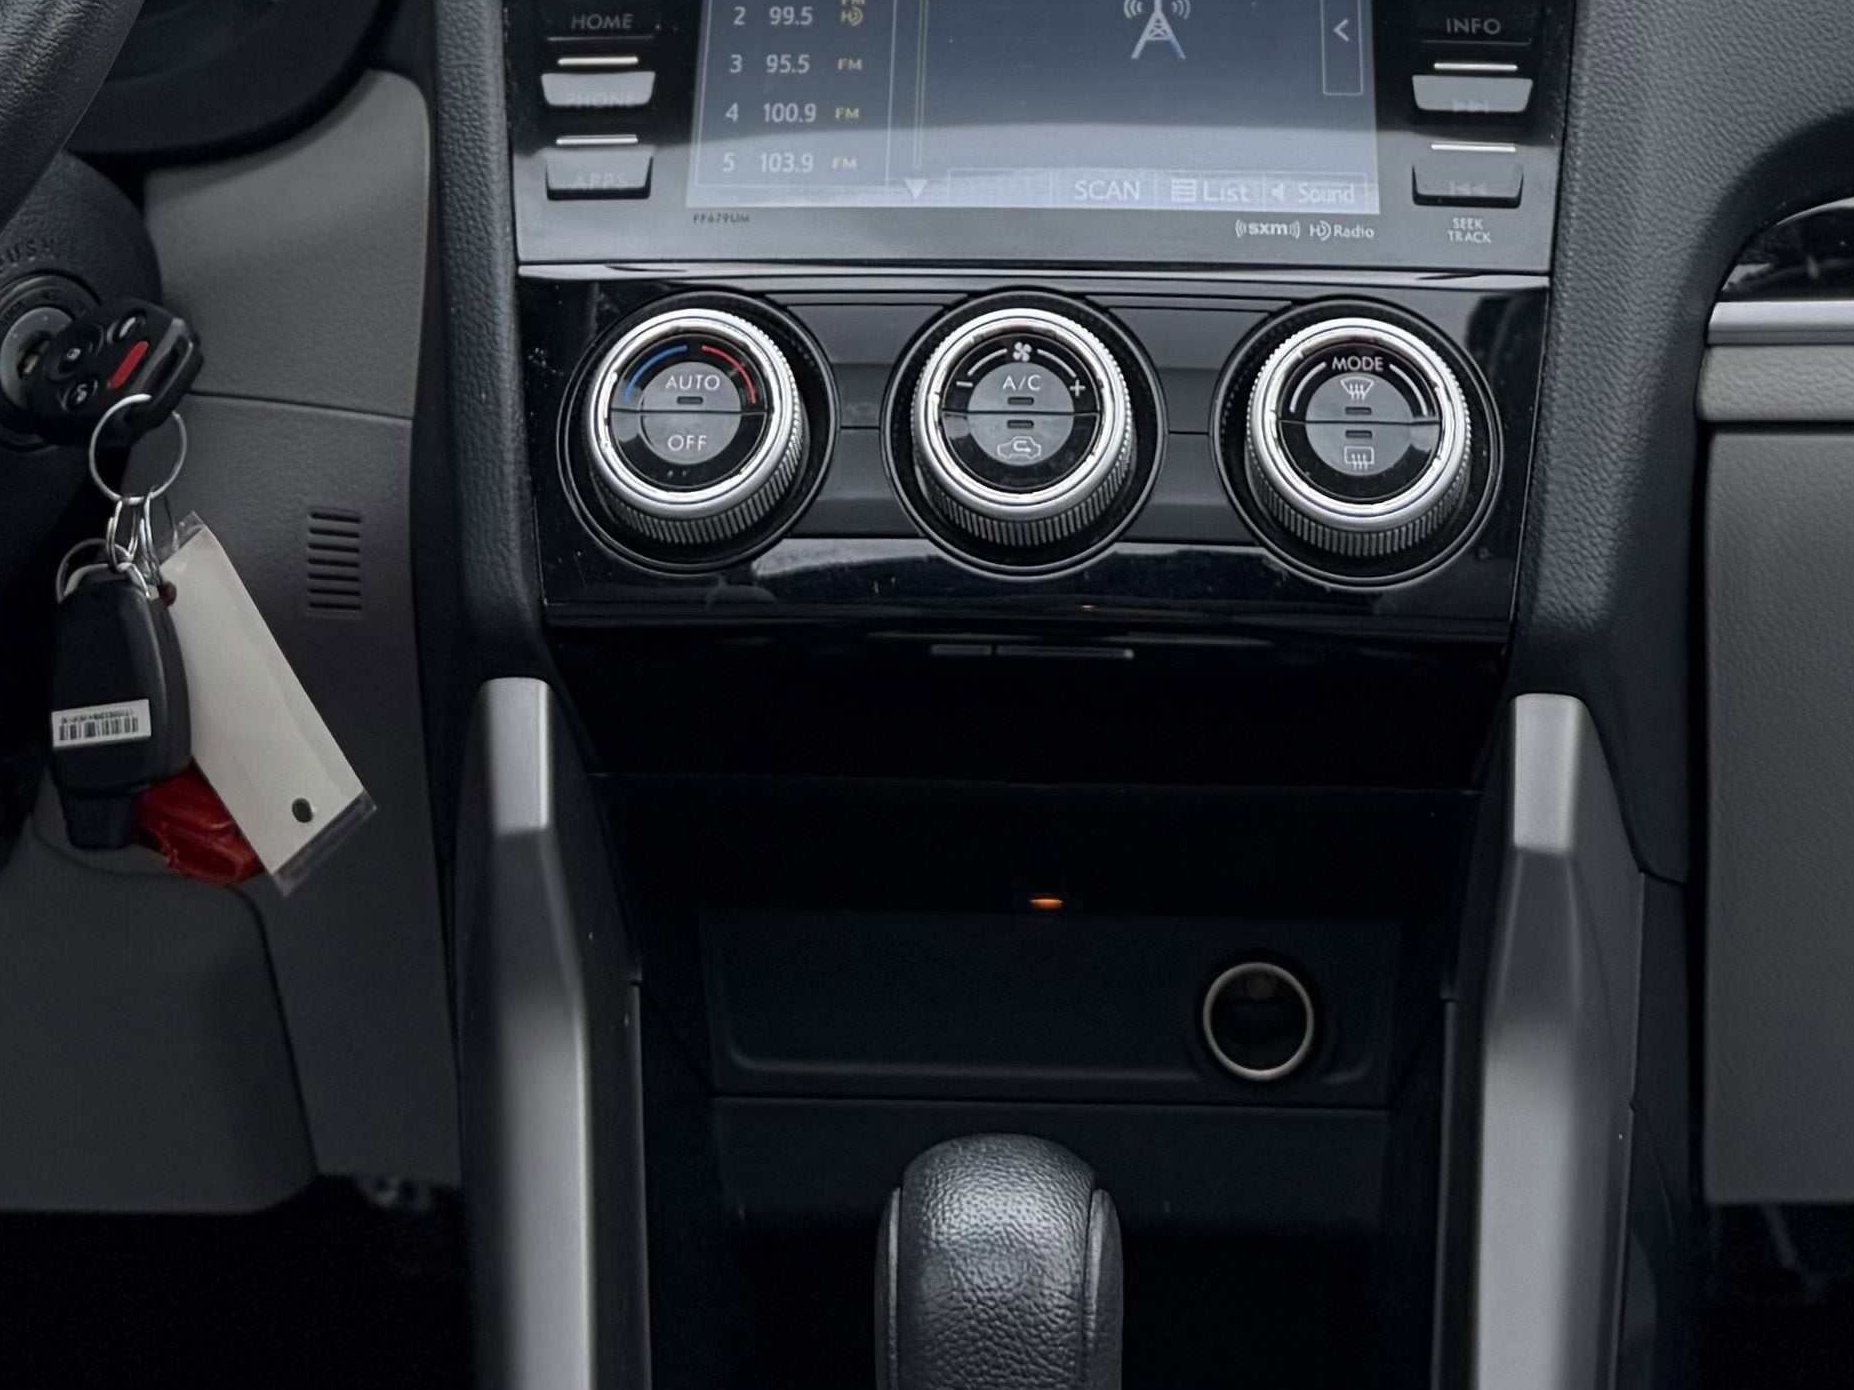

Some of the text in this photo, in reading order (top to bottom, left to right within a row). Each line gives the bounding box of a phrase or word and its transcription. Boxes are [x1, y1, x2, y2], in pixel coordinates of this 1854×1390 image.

[571, 13, 634, 31] HOME
[733, 6, 746, 25] 2
[769, 6, 813, 26] 99.5
[1446, 17, 1502, 35] INFO
[729, 54, 863, 74] 3 95.5 FM
[725, 103, 860, 124] 4 100.9 FM
[722, 152, 858, 173] 5 103.9 FM
[1074, 178, 1356, 204] SCAN List Sound
[1334, 224, 1375, 239] Radio
[1452, 217, 1484, 230] SEEK
[1447, 230, 1492, 244] TRACK
[1331, 356, 1384, 371] MODE
[665, 374, 721, 392] AUTO
[1002, 373, 1042, 392] A/C
[667, 434, 708, 452] OFF
